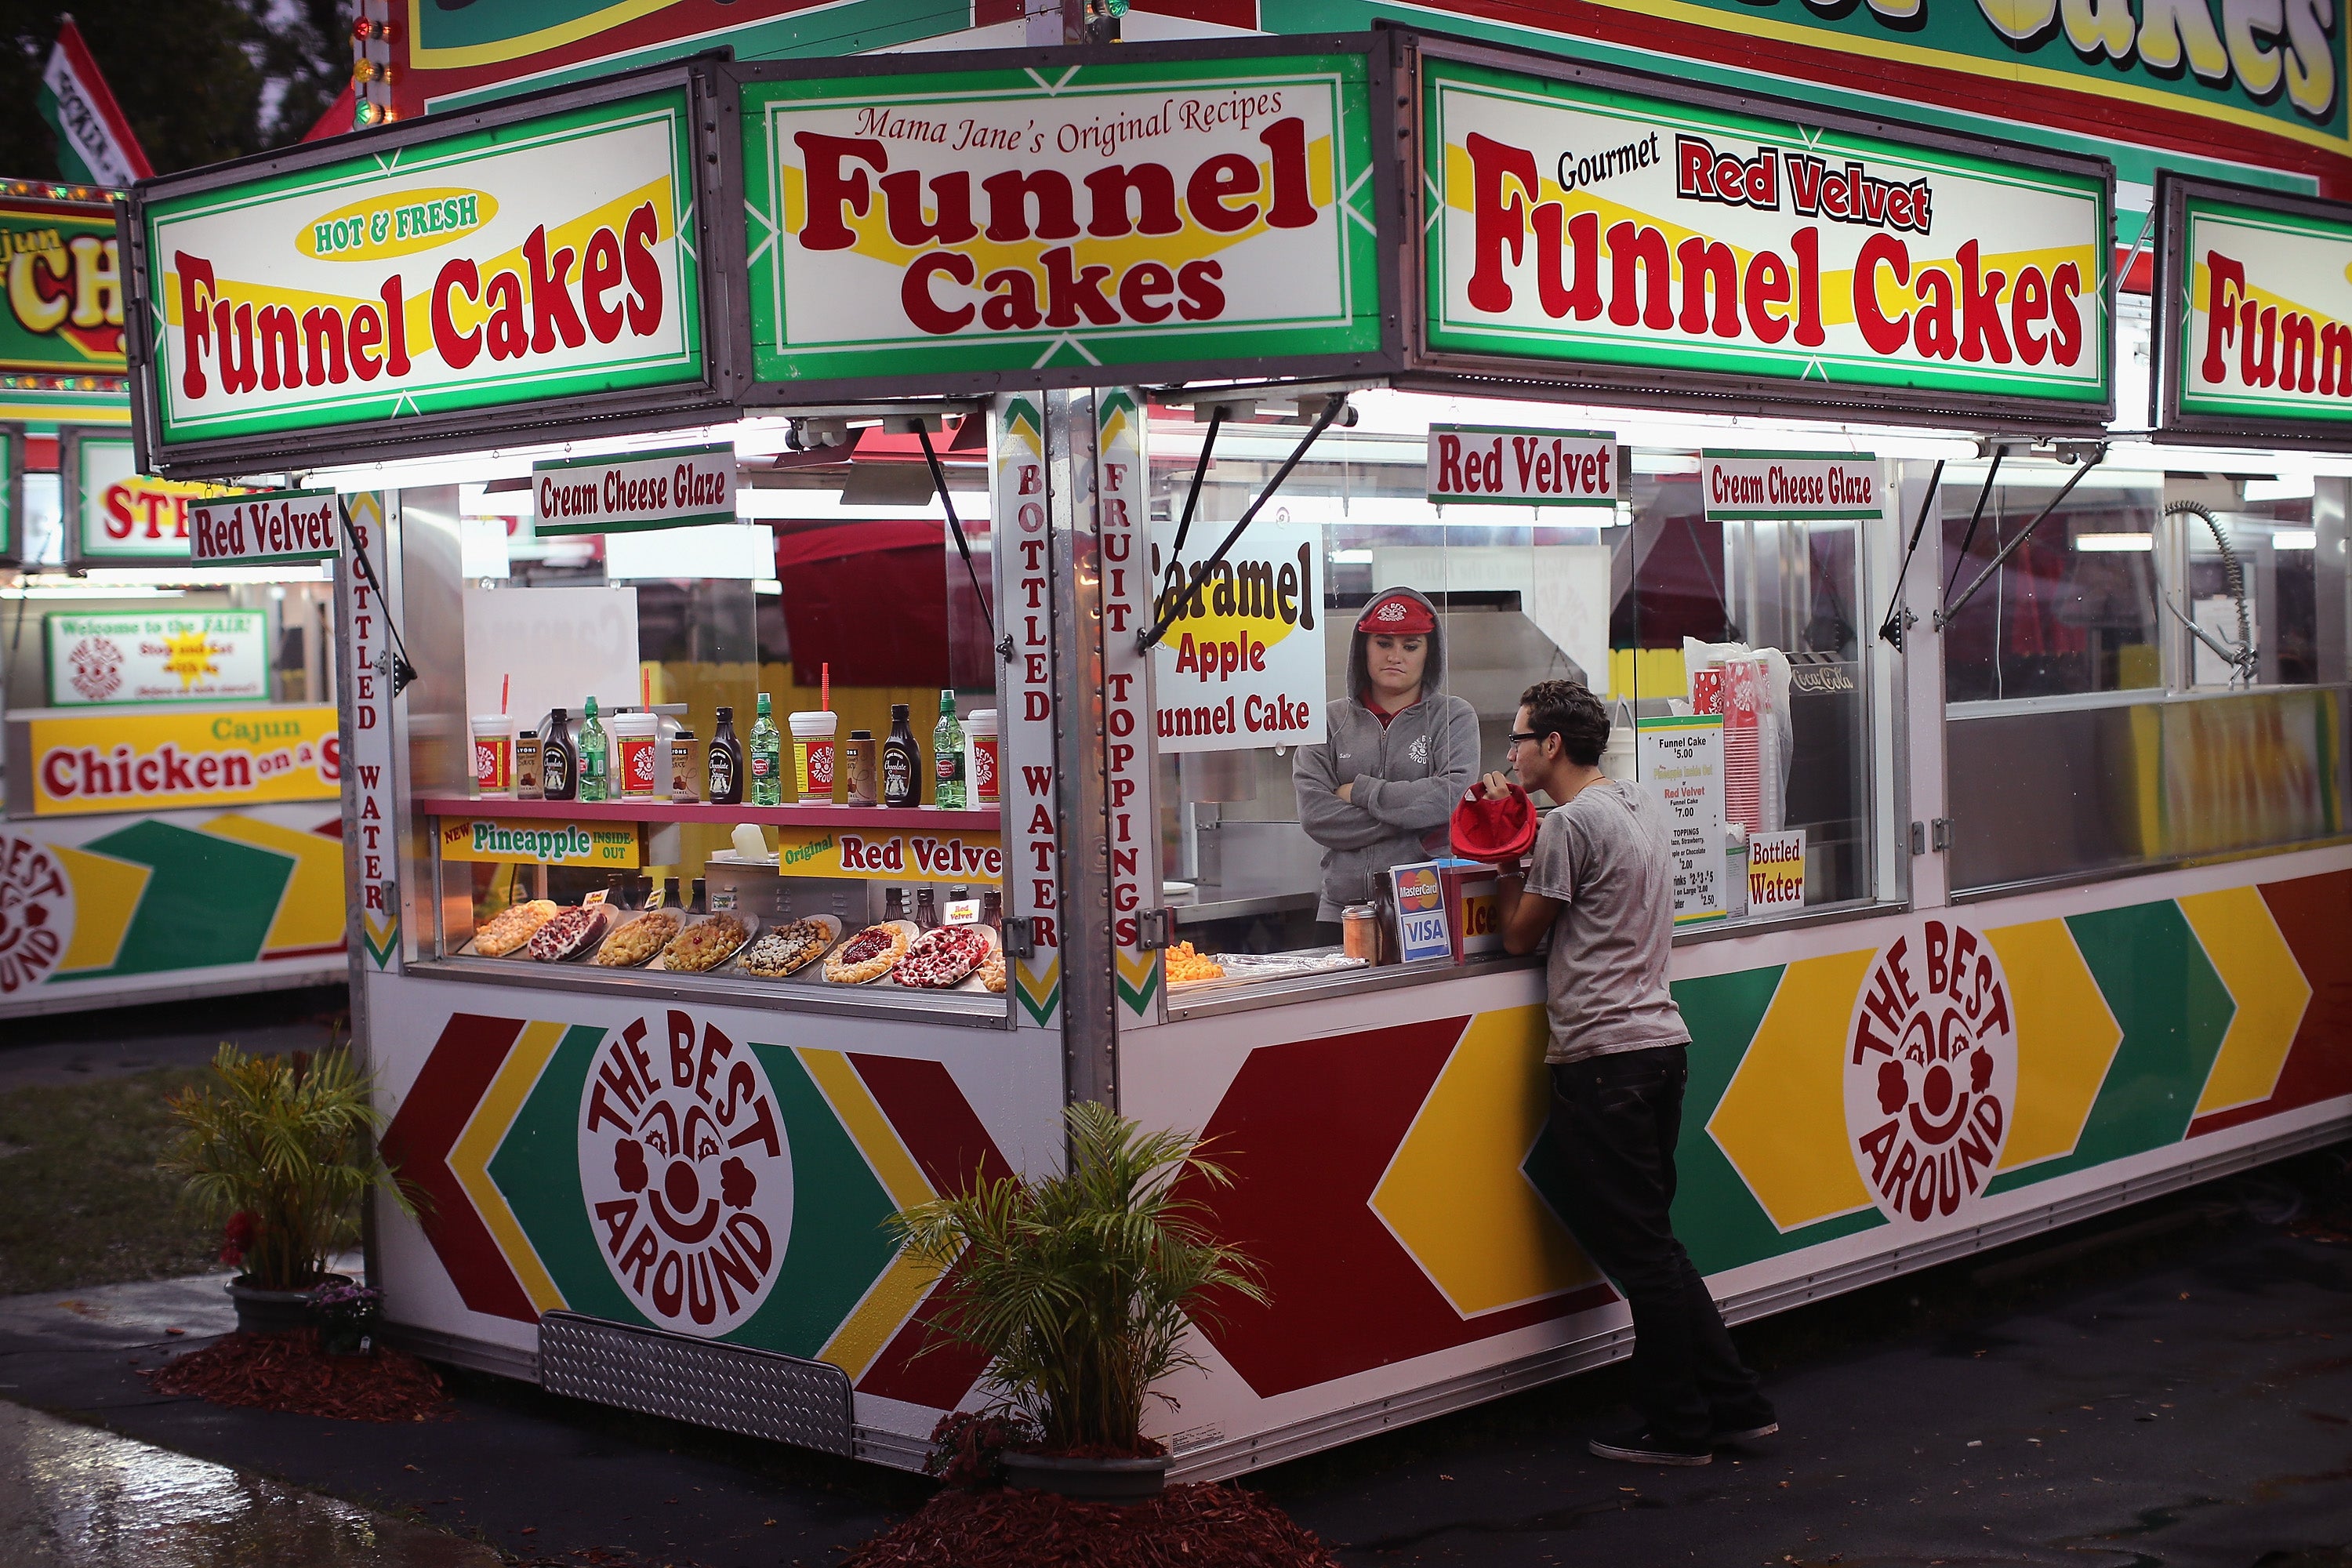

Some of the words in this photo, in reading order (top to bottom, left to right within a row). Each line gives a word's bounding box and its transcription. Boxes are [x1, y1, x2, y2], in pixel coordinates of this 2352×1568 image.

[854, 107, 947, 143] Mama
[953, 119, 1044, 153] Jane's
[1057, 100, 1173, 156] Original
[1178, 89, 1282, 132] Recipes
[794, 118, 1318, 250] Funnel
[1557, 131, 1661, 192] Gourmet
[1675, 133, 1780, 212] Red
[1784, 150, 1933, 235] Velvet
[315, 223, 364, 255] HOT
[371, 216, 390, 241] &
[396, 196, 477, 237] FRESH
[1466, 132, 1825, 347] Funnel
[1853, 233, 2082, 366] Cakes
[175, 250, 411, 399] Funnel
[431, 201, 662, 368] Cakes
[901, 246, 1225, 334] Cakes
[2201, 249, 2352, 396] Funn
[1437, 434, 1503, 493] Red
[1513, 436, 1610, 494] Velvet
[1711, 464, 1764, 504] Cream
[1769, 466, 1824, 504] Cheese
[1828, 466, 1871, 504] Glaze
[540, 477, 598, 518] Cream
[604, 470, 667, 513] Cheese
[673, 463, 724, 508] Glaze
[194, 506, 245, 557] Red
[249, 502, 333, 553] Velvet
[1104, 463, 1131, 632] FRUIT
[1018, 463, 1050, 721] BOTTLED
[1176, 630, 1266, 682] Apple
[1791, 666, 1853, 691] Coca-Cola
[212, 718, 300, 742] Cajun
[1244, 693, 1308, 732] Cake
[633, 747, 647, 763] THE
[810, 748, 824, 763] THE
[1659, 738, 1685, 748] Funnel
[1688, 737, 1706, 746] Cake
[1674, 748, 1693, 758] $5.00
[44, 748, 251, 797] Chicken
[259, 751, 289, 774] on
[299, 748, 313, 764] a
[884, 760, 906, 771] Chocolate
[1109, 673, 1140, 947] TOPPINGS
[1664, 788, 1679, 798] Red
[1682, 786, 1704, 797] Velvet
[1675, 807, 1693, 818] $7.00
[358, 766, 383, 910] WATER
[444, 822, 470, 844] NEW
[473, 822, 590, 858] Pineapple
[602, 848, 625, 859] OUT
[785, 833, 833, 865] Original
[841, 837, 903, 870] Red
[911, 837, 1002, 873] Velve
[1674, 828, 1699, 837] TOPPINGS
[1753, 838, 1799, 865] Bottled
[1022, 766, 1058, 947] WATER
[1679, 858, 1693, 869] $2.00
[1399, 883, 1436, 898] MasterCard
[1701, 895, 1714, 906] $2.50
[1750, 873, 1802, 905] Water
[1405, 919, 1443, 942] VISA
[1852, 935, 1919, 1065] THE
[1925, 920, 2010, 1040] BEST
[586, 1016, 662, 1135] THE
[666, 1010, 780, 1158] BEST
[1858, 1095, 2003, 1222] AROUND
[594, 1198, 772, 1326] AROUND
